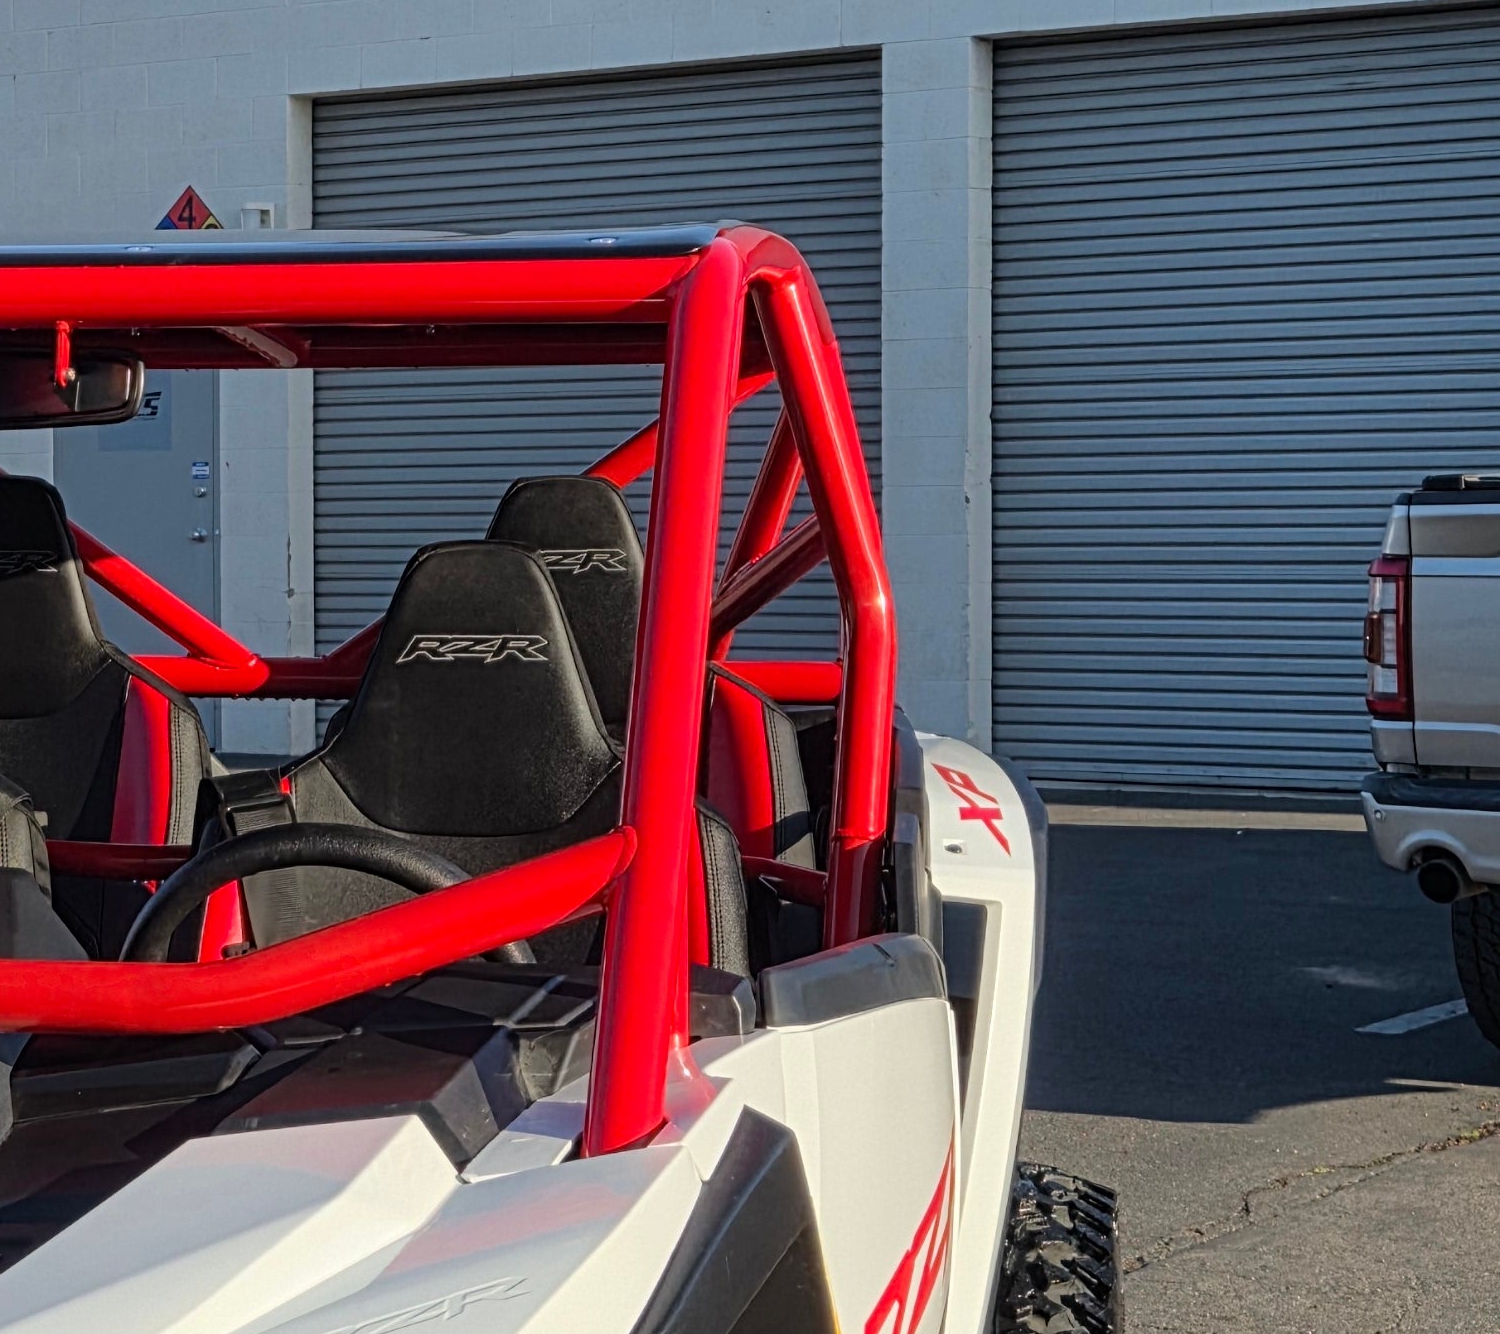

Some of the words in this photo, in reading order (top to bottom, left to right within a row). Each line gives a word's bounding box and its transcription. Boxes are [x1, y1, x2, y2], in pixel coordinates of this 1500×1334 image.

[178, 194, 197, 229] 4
[541, 549, 627, 574] ZR
[396, 634, 549, 664] RZR
[930, 762, 1012, 858] XP
